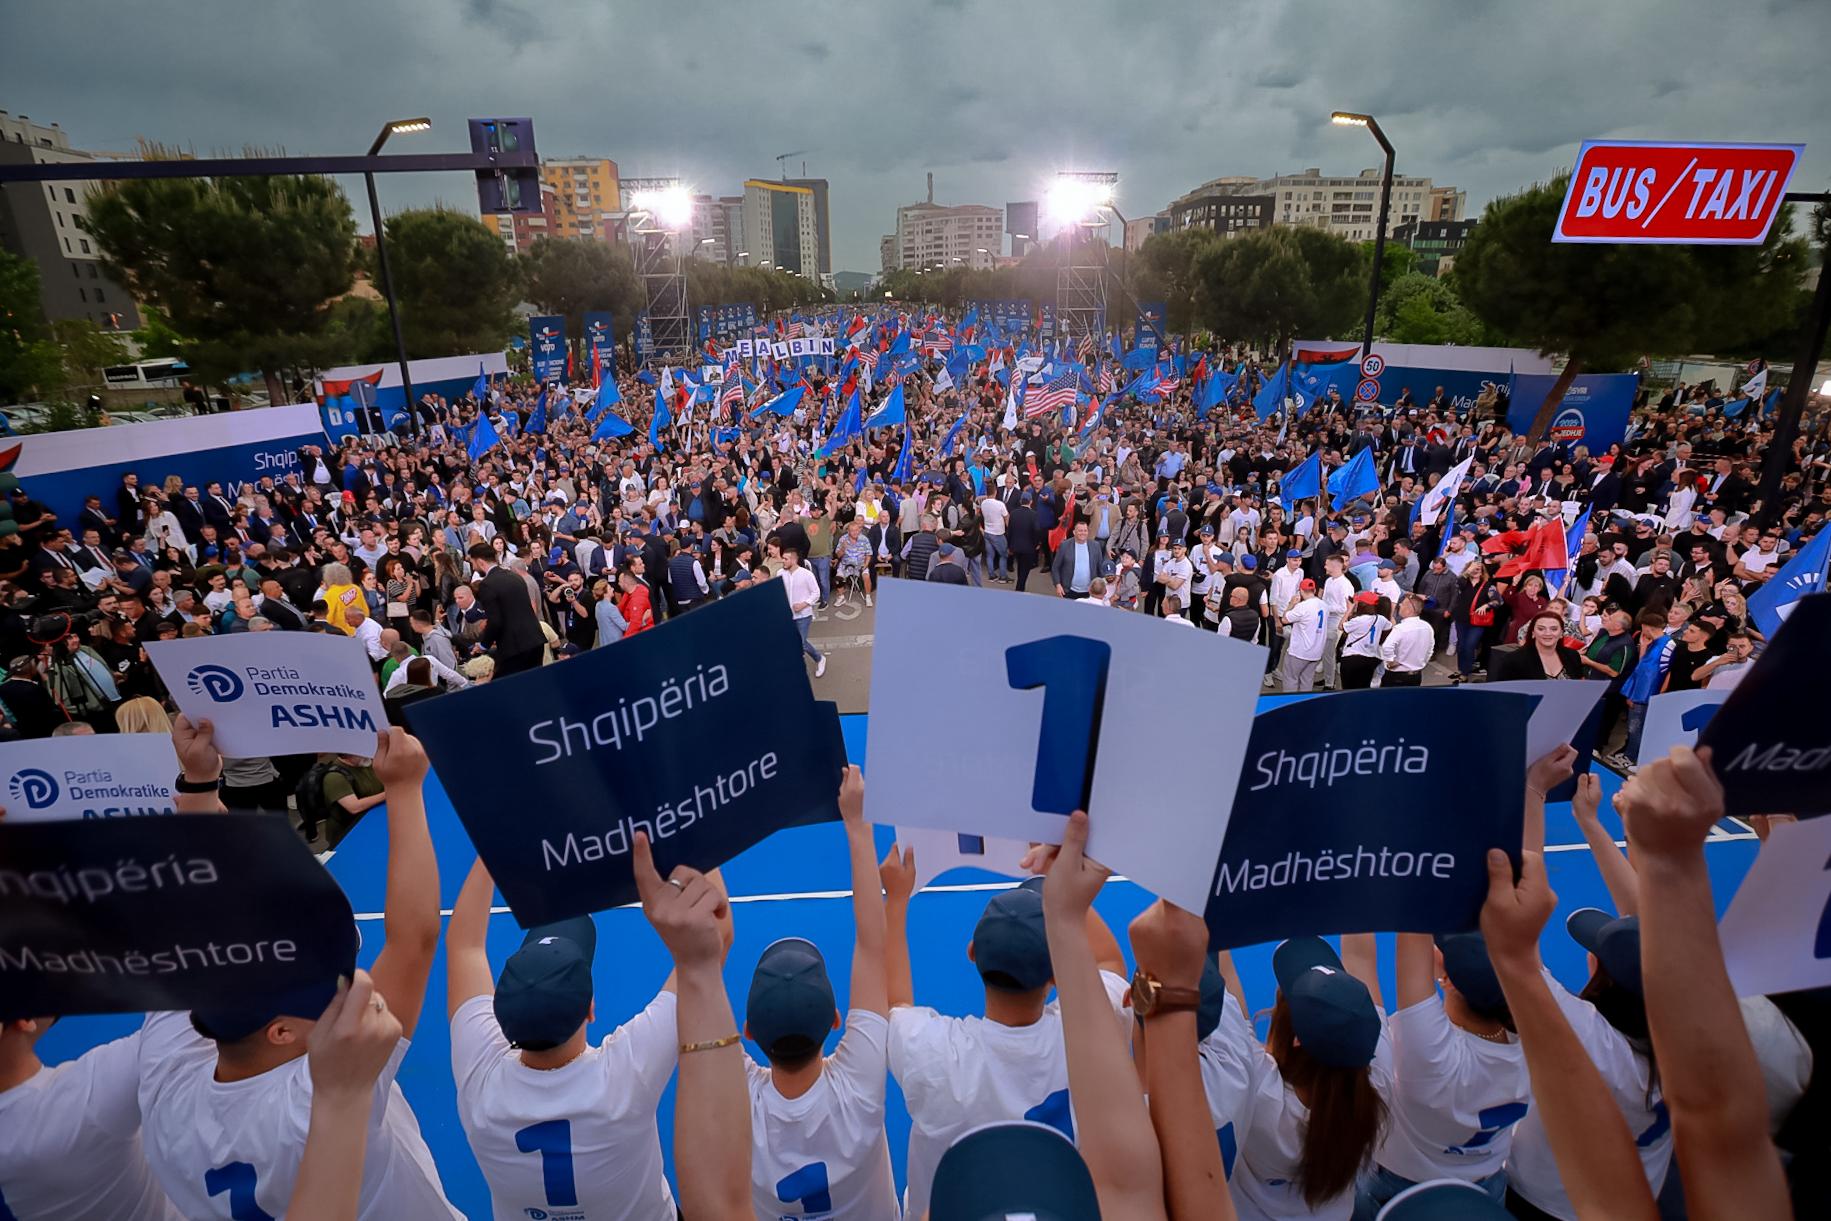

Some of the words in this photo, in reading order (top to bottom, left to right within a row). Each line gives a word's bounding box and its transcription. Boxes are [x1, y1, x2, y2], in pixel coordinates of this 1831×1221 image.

[1366, 360, 1380, 372] 50
[1317, 609, 1324, 629] 1
[246, 666, 299, 681] Partia
[254, 682, 366, 700] Demokratike
[271, 703, 378, 733] ASHM
[528, 664, 729, 765] Shqipëria
[1004, 634, 1112, 816] 1
[64, 769, 113, 785] Partia
[1250, 737, 1429, 791] Shqipëria
[70, 784, 170, 801] Demokratike
[541, 751, 777, 871] Madhështore
[1215, 845, 1455, 897] Madhështore
[0, 939, 297, 974] Madhështore
[514, 1118, 579, 1207] 1
